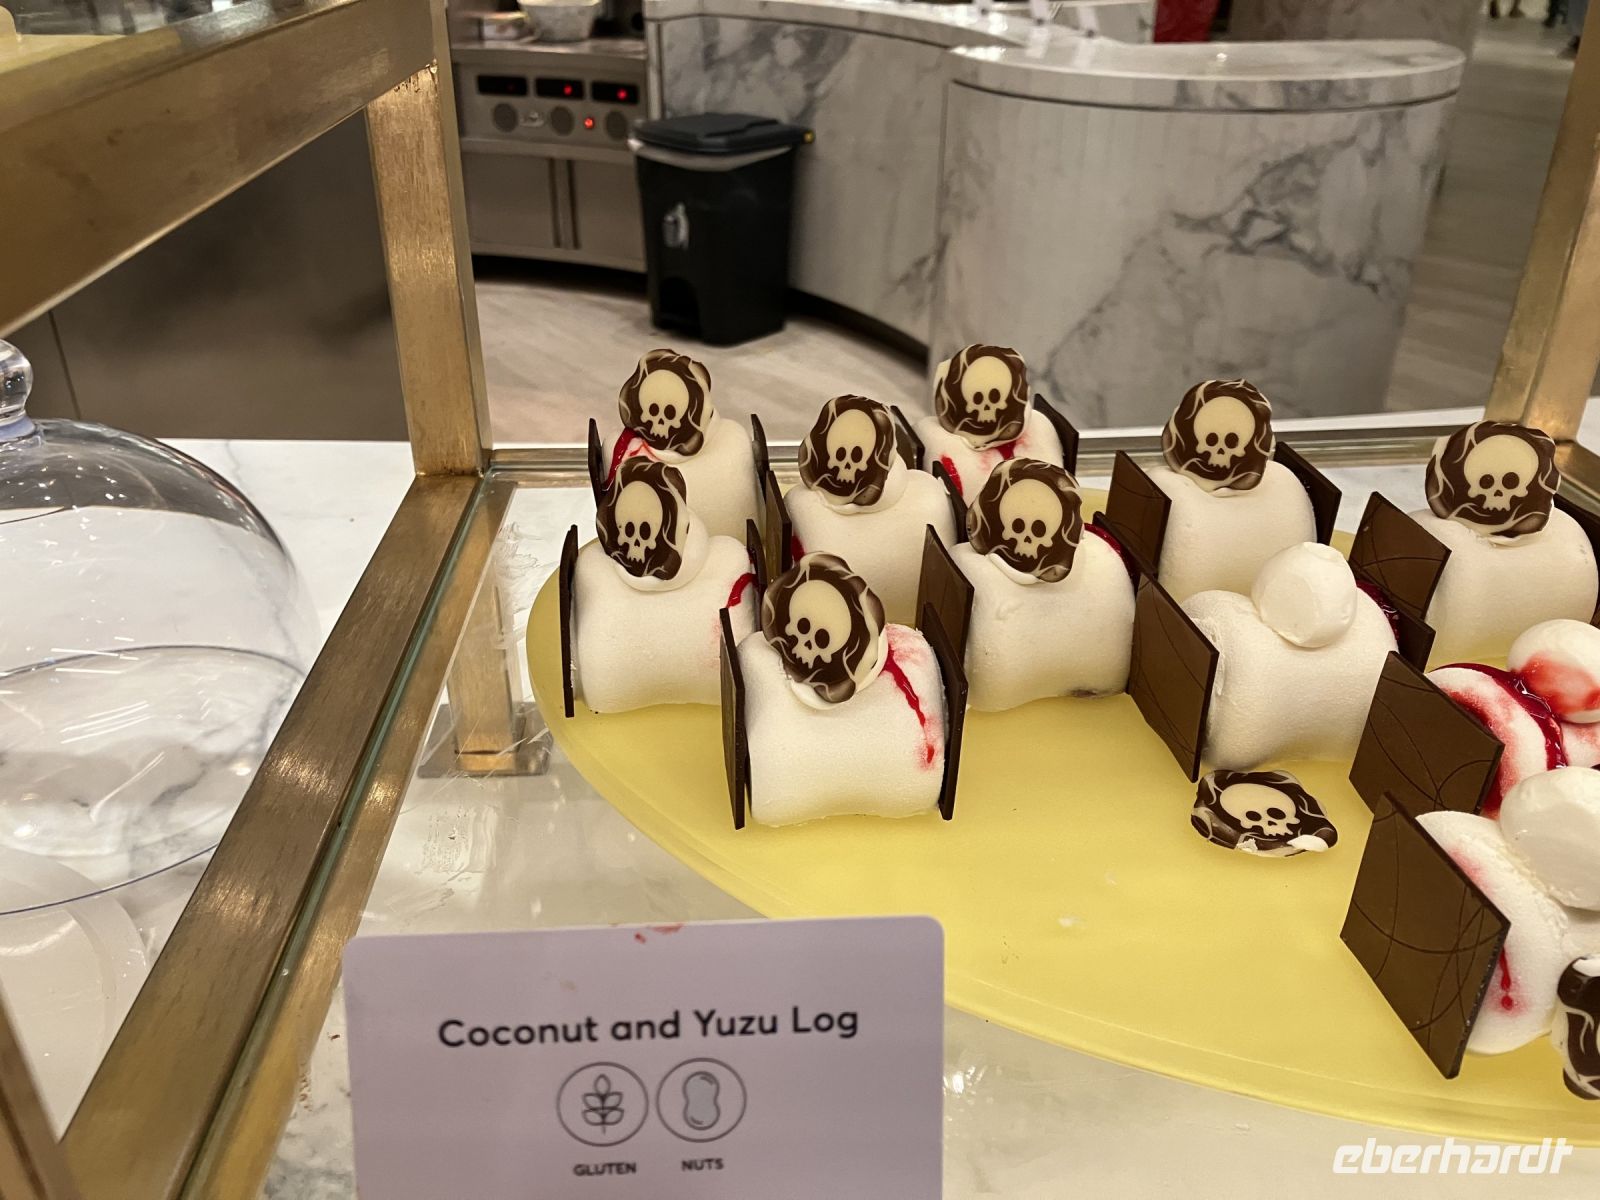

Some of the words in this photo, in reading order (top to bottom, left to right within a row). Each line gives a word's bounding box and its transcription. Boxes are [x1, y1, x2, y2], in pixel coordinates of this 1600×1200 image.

[438, 1015, 600, 1048] Coconut
[610, 1009, 681, 1041] and
[692, 1008, 779, 1039] Yuzu
[791, 1006, 860, 1040] Log
[572, 1160, 637, 1177] GLUTEN
[680, 1156, 725, 1173] NUTS
